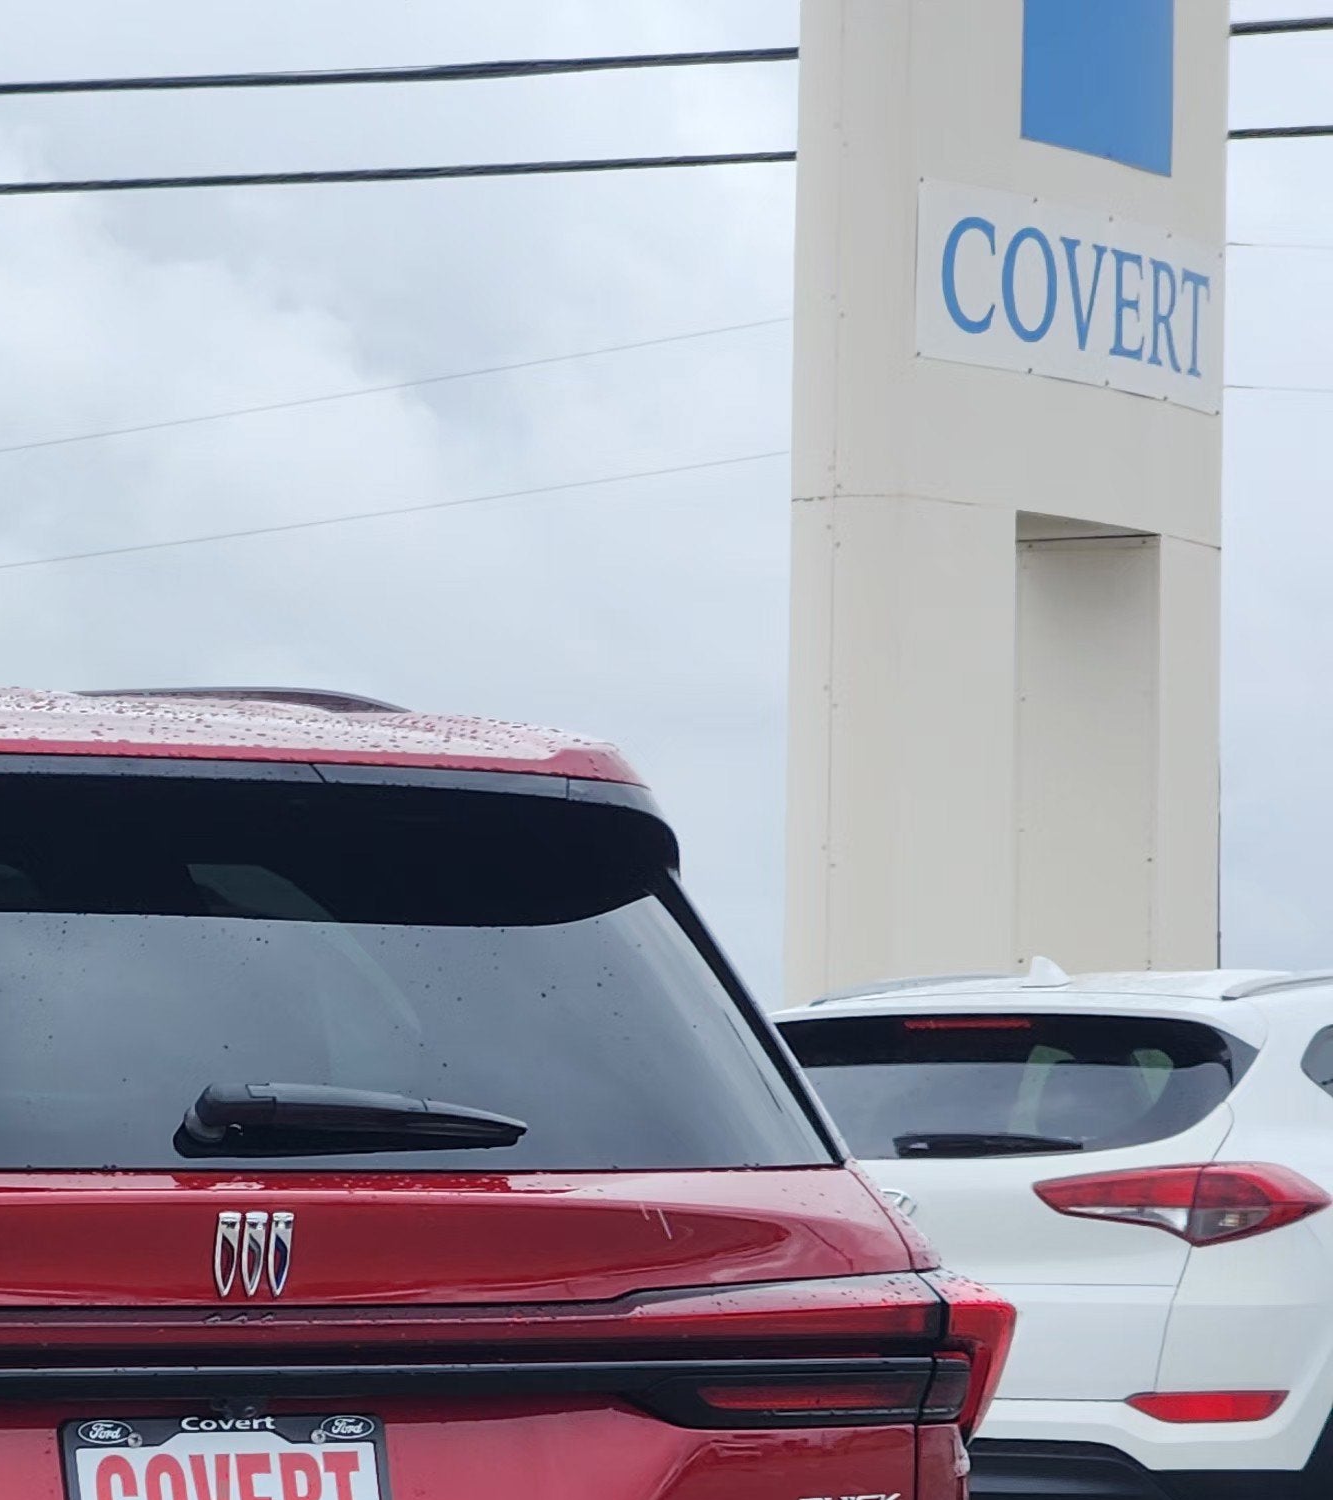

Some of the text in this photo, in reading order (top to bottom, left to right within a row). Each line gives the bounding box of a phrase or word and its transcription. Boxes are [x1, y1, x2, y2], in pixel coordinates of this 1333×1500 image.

[941, 215, 1211, 378] COVERT
[88, 1422, 121, 1440] Ford
[181, 1416, 276, 1431] Covert
[331, 1418, 364, 1434] Ford
